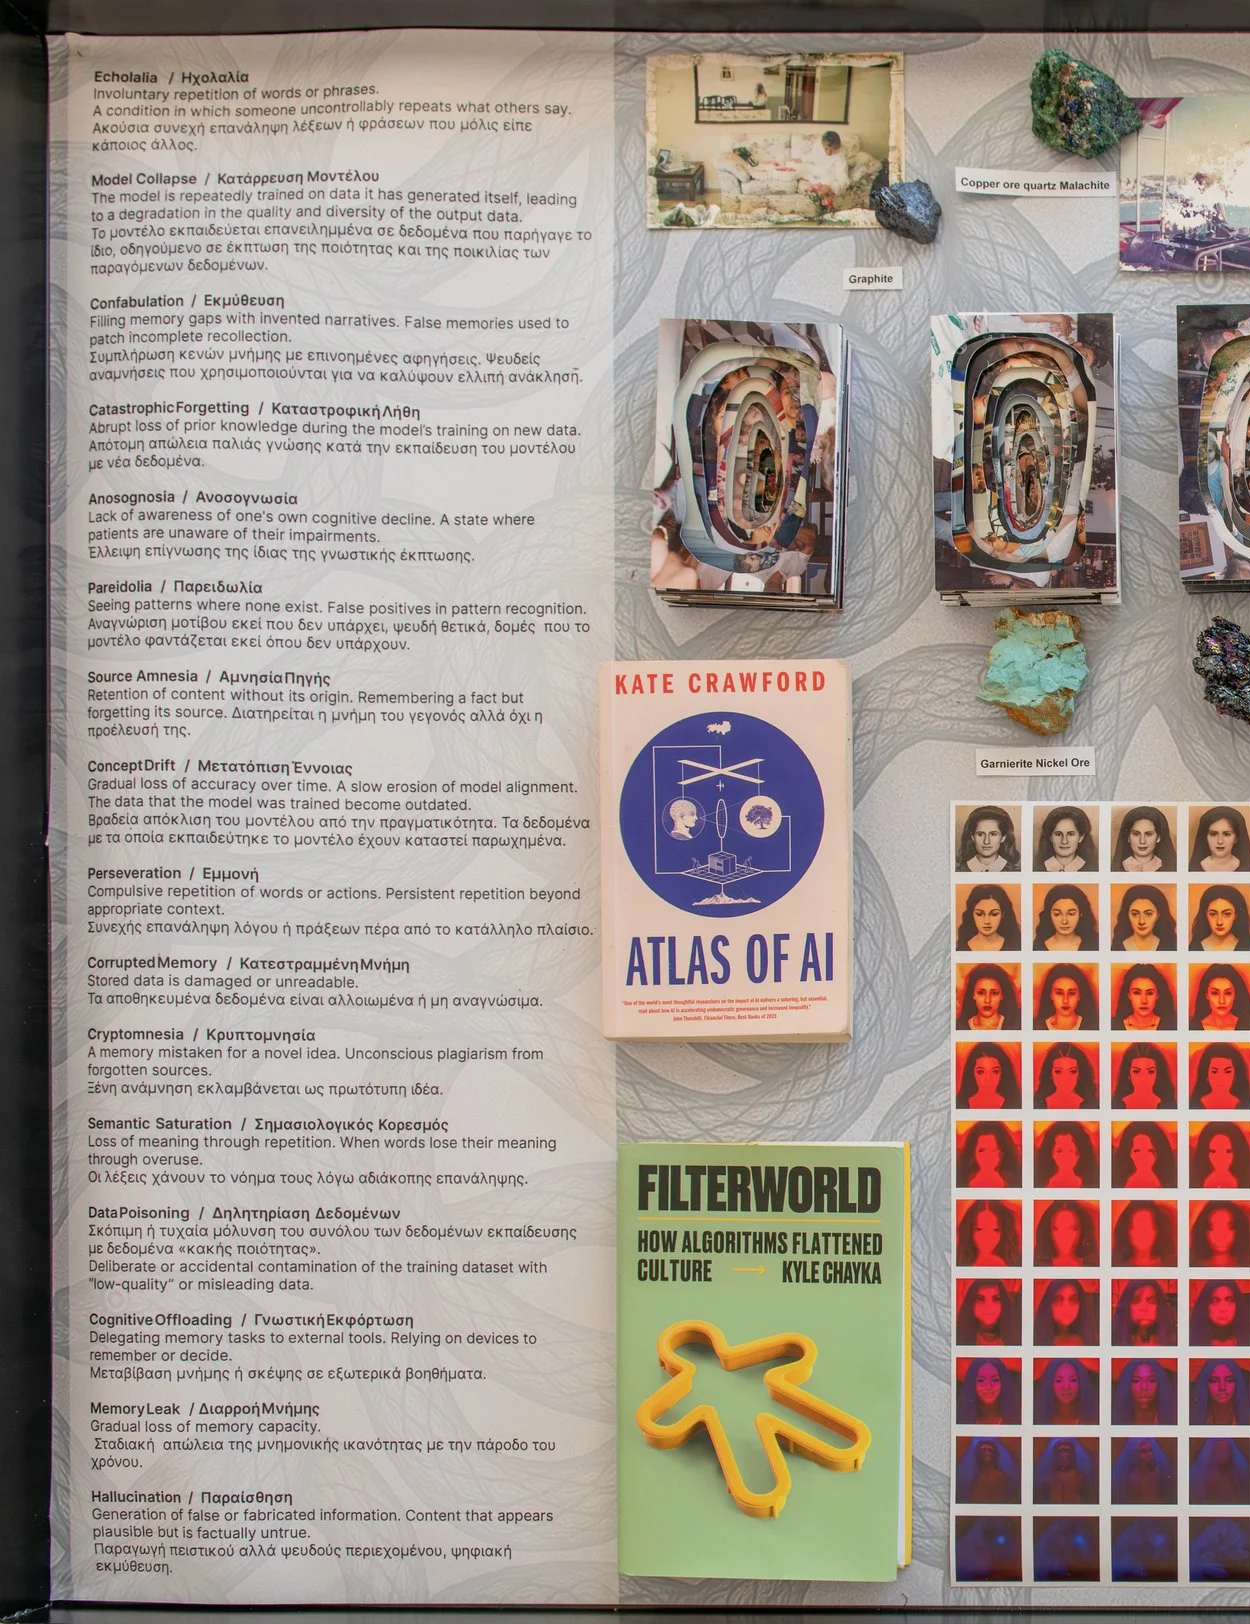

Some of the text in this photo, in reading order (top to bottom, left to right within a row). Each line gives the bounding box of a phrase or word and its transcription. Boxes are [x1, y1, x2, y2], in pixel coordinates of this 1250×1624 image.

[94, 71, 157, 83] Echolalia
[182, 70, 249, 86] Ηχολαλία
[94, 85, 379, 103] Involuntary repetition of words or phrases.
[93, 138, 197, 152] κάποιος άλλος.
[92, 173, 132, 187] Model
[136, 173, 197, 187] Collapse
[218, 172, 303, 187] Κατάρρευση
[307, 169, 379, 182] Μοντέλου
[961, 177, 1110, 192] Copper ore quartz Malachite
[91, 258, 268, 276] παραγόμενων δεδομένων.
[849, 274, 893, 285] Graphite
[90, 295, 184, 310] Confabulation
[204, 293, 284, 309] Εκμύθευση
[90, 330, 291, 348] patch incomplete recollection.
[89, 454, 204, 472] με νέα δεδομένα.
[89, 490, 175, 506] Anosognosia
[196, 491, 297, 507] Ανοσογνωσία
[89, 527, 380, 544] patients are unaware of their impairments.
[88, 580, 152, 594] Pareidolia
[174, 580, 262, 595] Παρειδωλία
[88, 633, 410, 653] μοντέλο φαντάζεται εκεί όπου δεν υπάρχουν.
[616, 671, 824, 694] KATE CRAWFORD
[88, 723, 190, 739] προέλευσή της.
[981, 758, 1090, 768] Garnierite Nickel Ore
[88, 866, 181, 879] Perseveration
[203, 867, 259, 883] Εμμονή
[88, 902, 224, 918] appropriate context.
[626, 933, 833, 985] ATLAS OF AI
[88, 974, 358, 990] Stored data is damaged or unreadable.
[88, 1028, 184, 1043] Cryptomnesia
[207, 1028, 315, 1044] Κρυπτομνησία
[88, 1063, 211, 1079] forgotten sources.
[88, 1081, 443, 1098] Ξένη ανάμνηση εκλαμβάνεται ως πρωτότυπη ιδέα.
[88, 1117, 150, 1129] Semantic
[156, 1117, 231, 1130] Saturation
[255, 1118, 373, 1133] Σημασιολογικός
[379, 1118, 448, 1133] Κορεσμός
[88, 1153, 202, 1168] through overuse.
[639, 1165, 881, 1213] FILTERWORLD
[89, 1245, 103, 1257] με
[107, 1242, 173, 1257] δεδομένα
[638, 1230, 882, 1255] HOW ALGORITHMS FLATTENED
[638, 1259, 712, 1281] CULTURE
[783, 1261, 881, 1284] KYLE CHAYKA
[179, 1281, 193, 1290] or
[198, 1278, 274, 1293] misleading
[279, 1278, 313, 1290] data.
[90, 1349, 232, 1361] remember or decide.
[91, 1420, 320, 1435] Gradual loss of memory capacity.
[91, 1455, 142, 1470] χρόνου.
[92, 1490, 181, 1503] Hallucination
[201, 1491, 292, 1506] Παραίσθηση
[93, 1525, 310, 1542] plausible but is factually untrue.
[96, 1559, 172, 1575] εκμύθευση.
